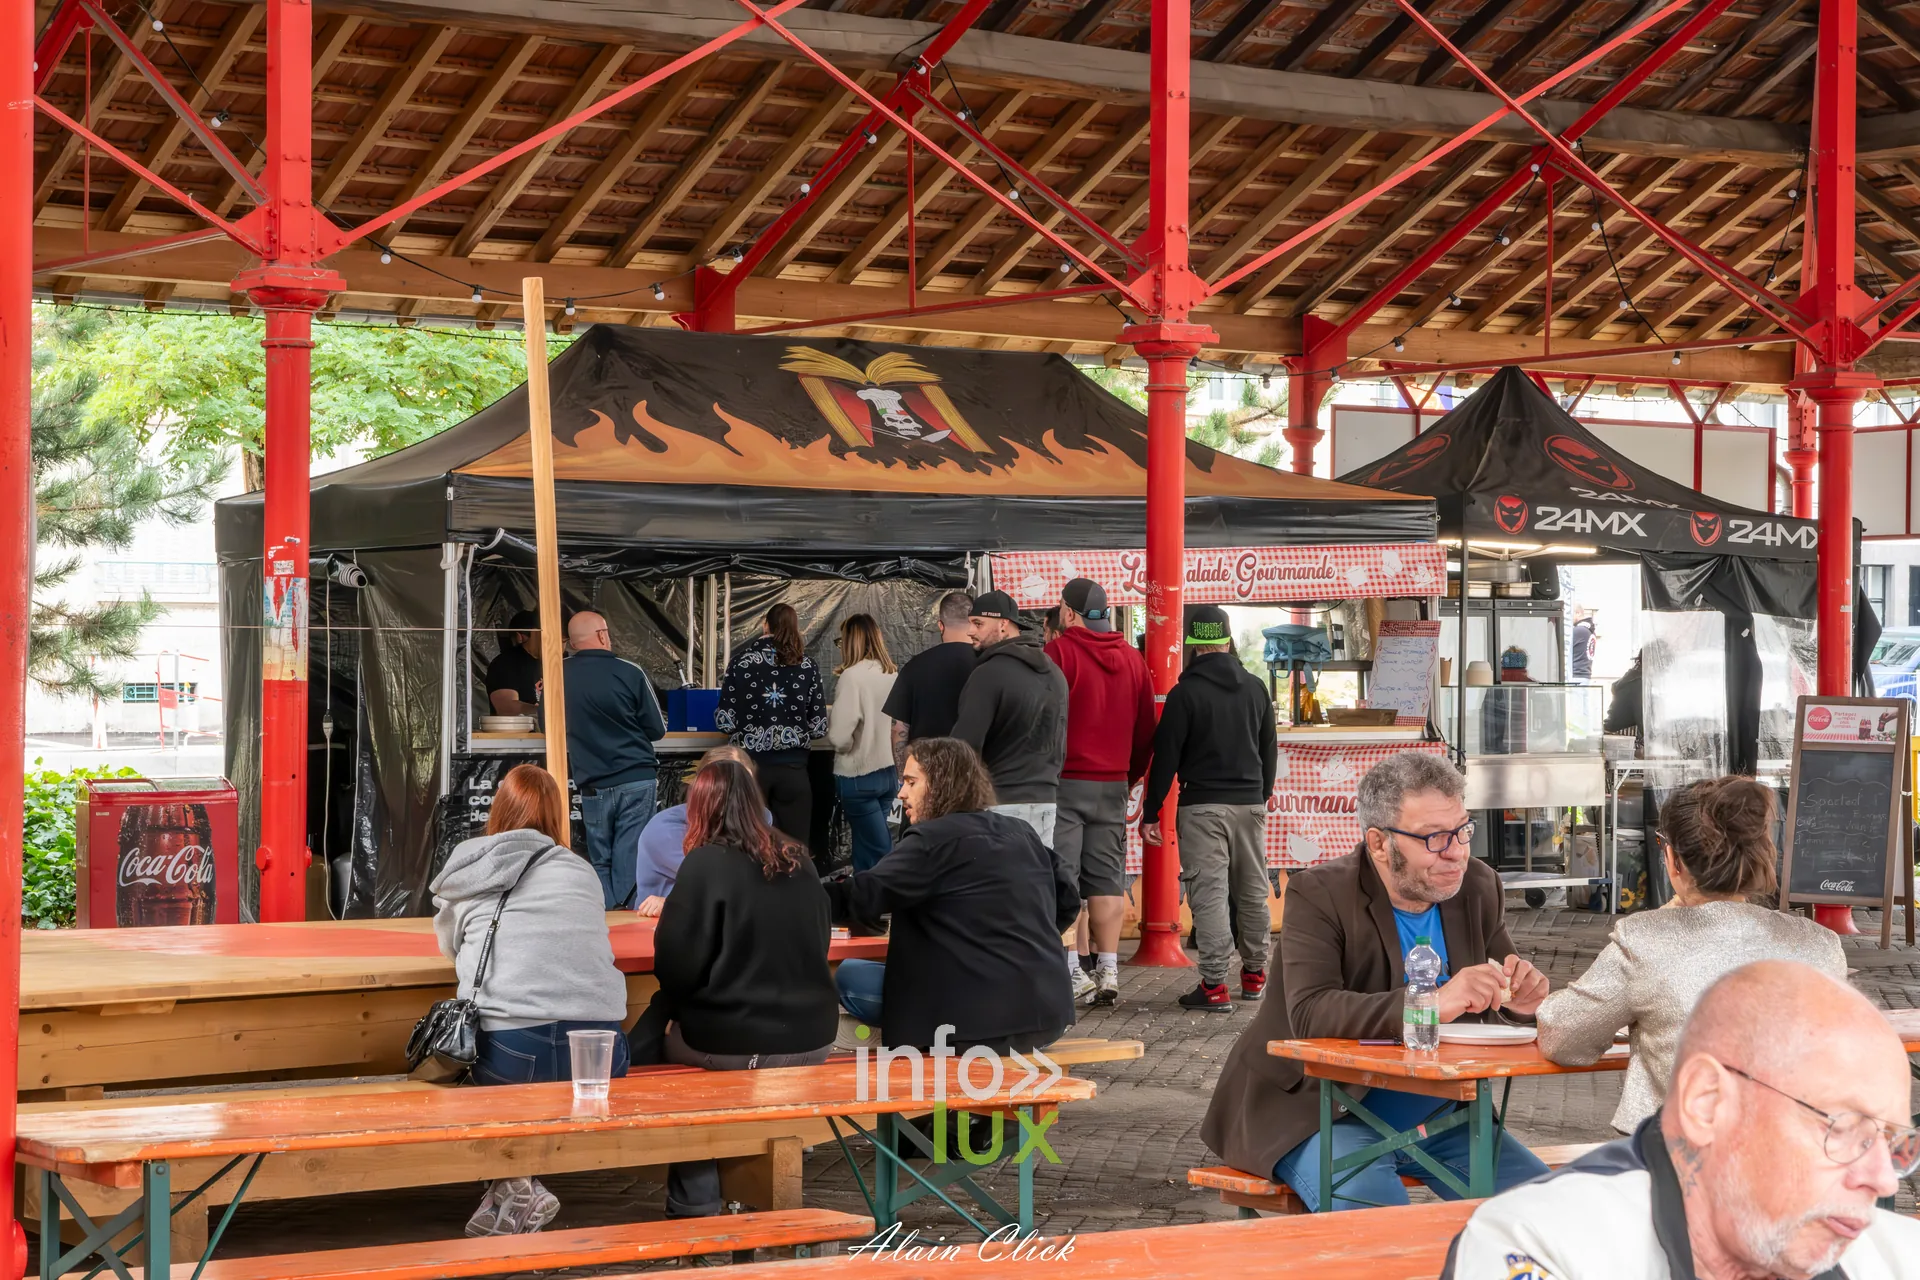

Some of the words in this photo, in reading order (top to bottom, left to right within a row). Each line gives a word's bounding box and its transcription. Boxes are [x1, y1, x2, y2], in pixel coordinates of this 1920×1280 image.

[1534, 506, 1648, 537] 24MX
[1184, 557, 1231, 583] alade
[1235, 552, 1336, 598] Gourmande
[469, 778, 492, 790] La
[118, 844, 214, 887] Coca-Cola
[1820, 879, 1855, 892] Coca-Cola
